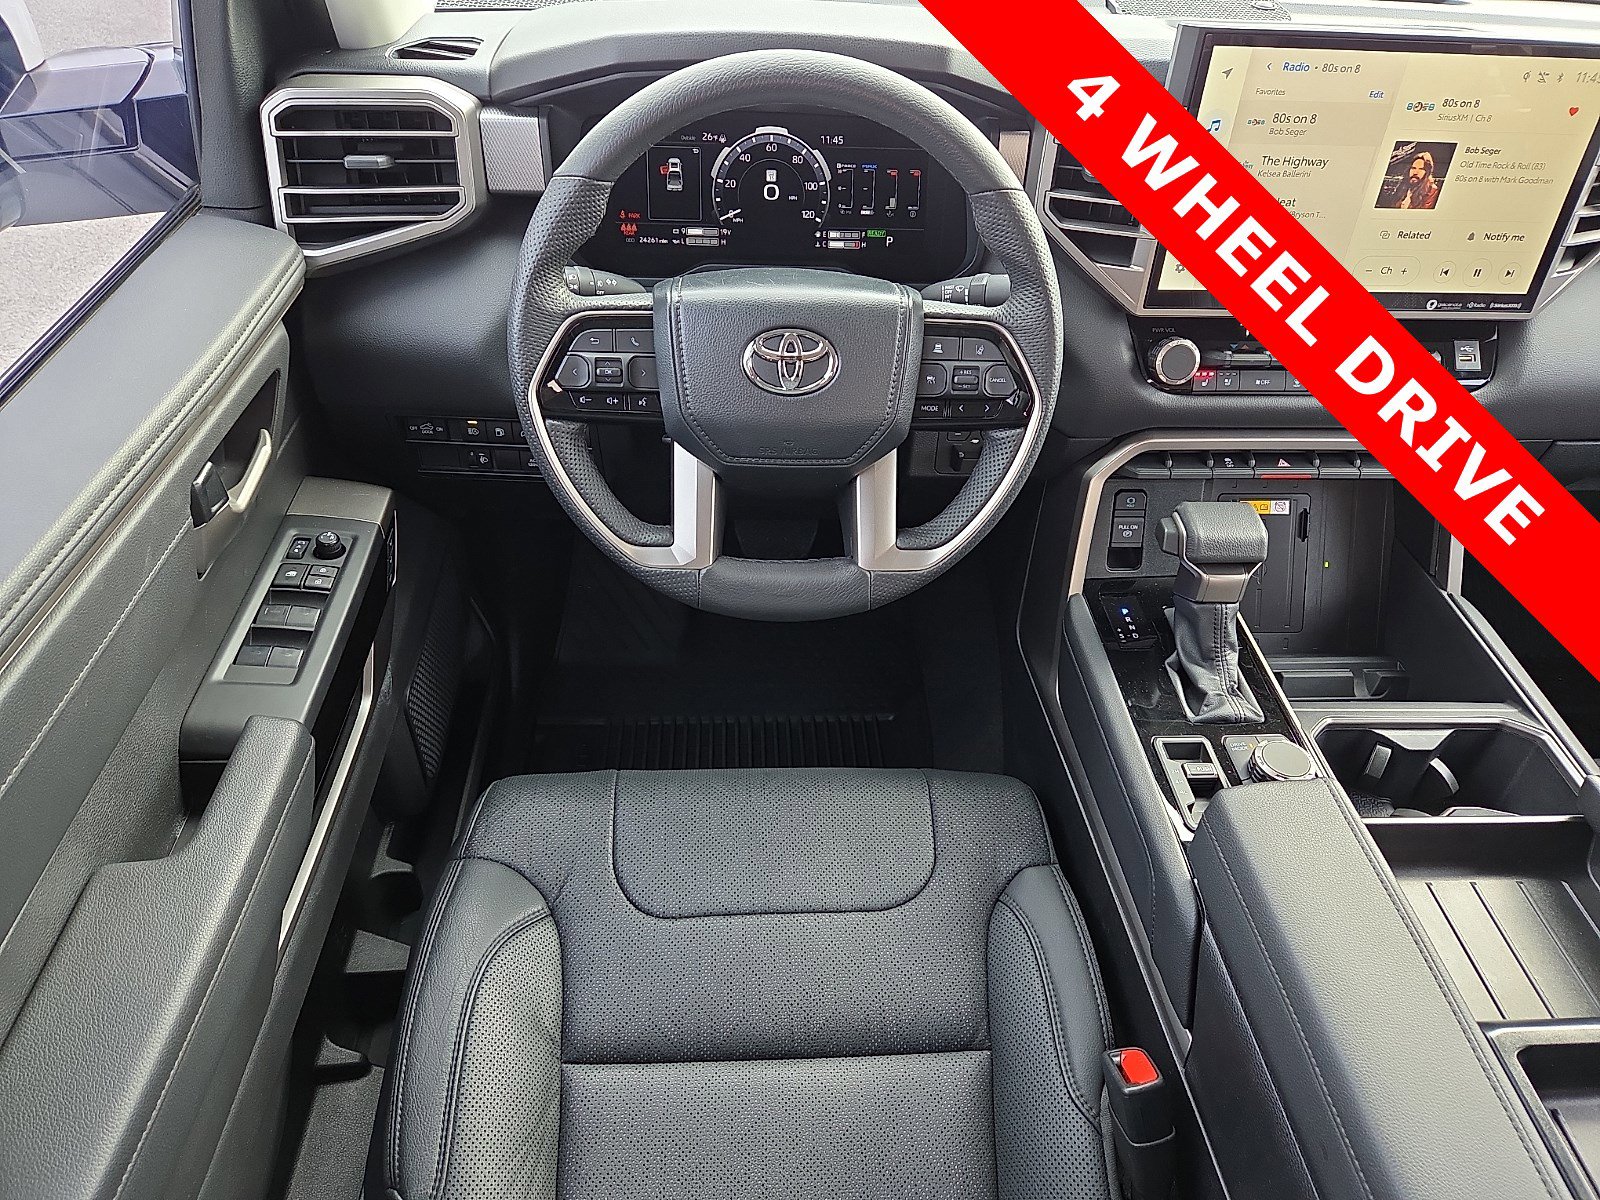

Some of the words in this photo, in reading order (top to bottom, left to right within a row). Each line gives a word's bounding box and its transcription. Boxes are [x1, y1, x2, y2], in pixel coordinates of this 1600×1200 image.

[1282, 62, 1310, 72] Radio
[1321, 63, 1338, 73] 80s
[1354, 64, 1361, 74] 8
[1255, 88, 1286, 96] Favorites
[1368, 91, 1384, 99] Edit
[1442, 98, 1459, 108] 80s
[1460, 100, 1472, 108] on
[1474, 100, 1480, 108] 8
[1272, 113, 1291, 124] 80s
[1293, 115, 1308, 124] on
[1310, 113, 1317, 124] 8
[1437, 113, 1468, 121] SiriusXM
[1269, 127, 1284, 136] Bob
[1285, 128, 1307, 138] Seger
[820, 135, 844, 145] 11:45
[765, 143, 778, 152] 60
[1465, 146, 1480, 154] Bob
[1480, 147, 1502, 156] Seger
[739, 153, 751, 162] 40
[792, 155, 804, 164] 80
[1262, 155, 1281, 166] The
[1282, 156, 1329, 169] Highway
[1475, 161, 1492, 169] Time
[1517, 162, 1531, 170] Roll
[1531, 162, 1546, 170] (83)
[1257, 169, 1281, 177] Kelsea
[1282, 170, 1311, 178] Ballerini
[724, 179, 737, 188] 20
[1518, 176, 1554, 184] Goodman
[804, 181, 818, 190] 100
[763, 183, 780, 201] 0
[1276, 197, 1297, 207] eat
[801, 210, 815, 219] 120
[1397, 230, 1432, 240] Related
[1483, 232, 1511, 243] Notify
[1511, 234, 1525, 242] me
[639, 236, 658, 244] 24261
[861, 240, 867, 248] H
[886, 236, 894, 247] P
[1380, 266, 1393, 275] Ch
